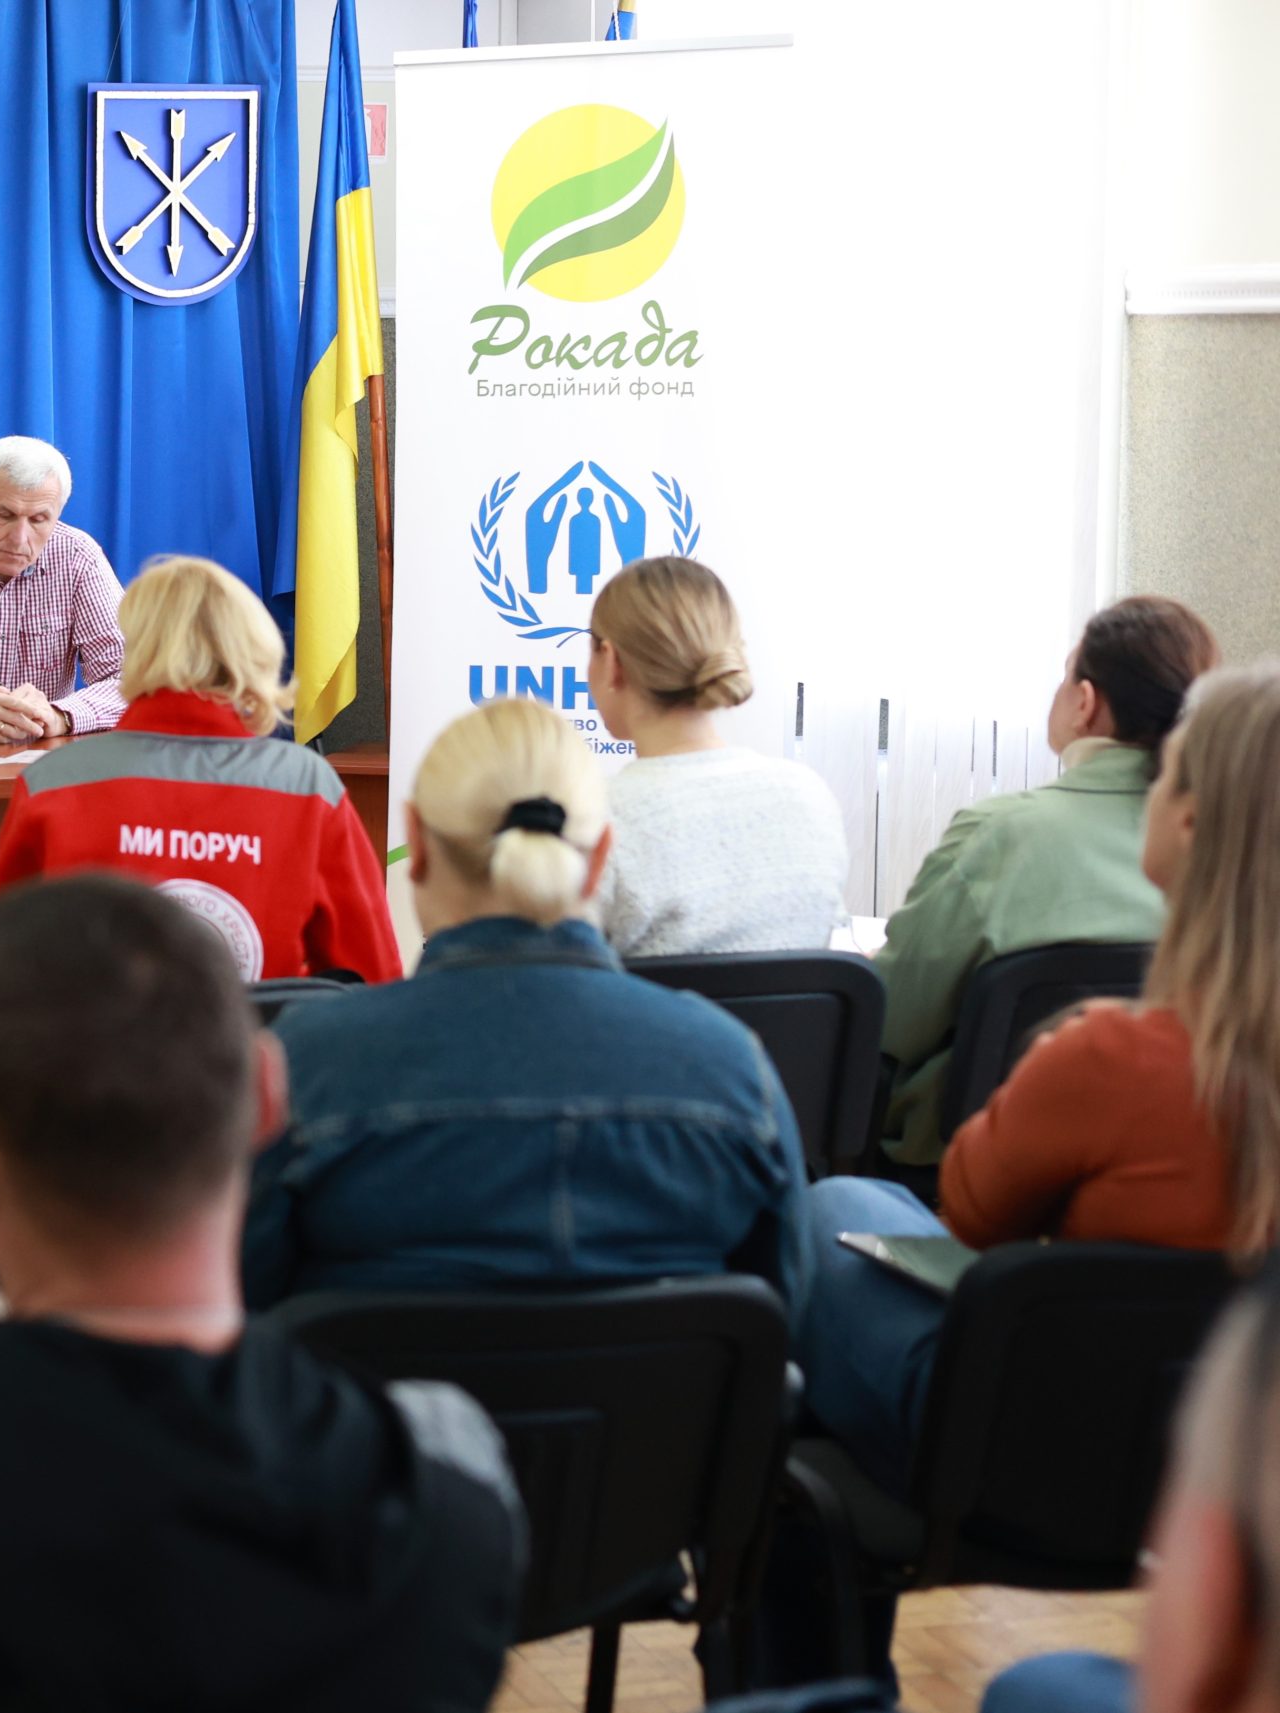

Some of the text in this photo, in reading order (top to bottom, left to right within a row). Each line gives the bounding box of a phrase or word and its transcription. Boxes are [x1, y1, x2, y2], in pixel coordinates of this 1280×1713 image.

[467, 299, 705, 376] Рокада
[476, 375, 695, 401] Благодійний фонд
[469, 664, 598, 710] UNH
[120, 823, 262, 866] МИ ПОРУЧ
